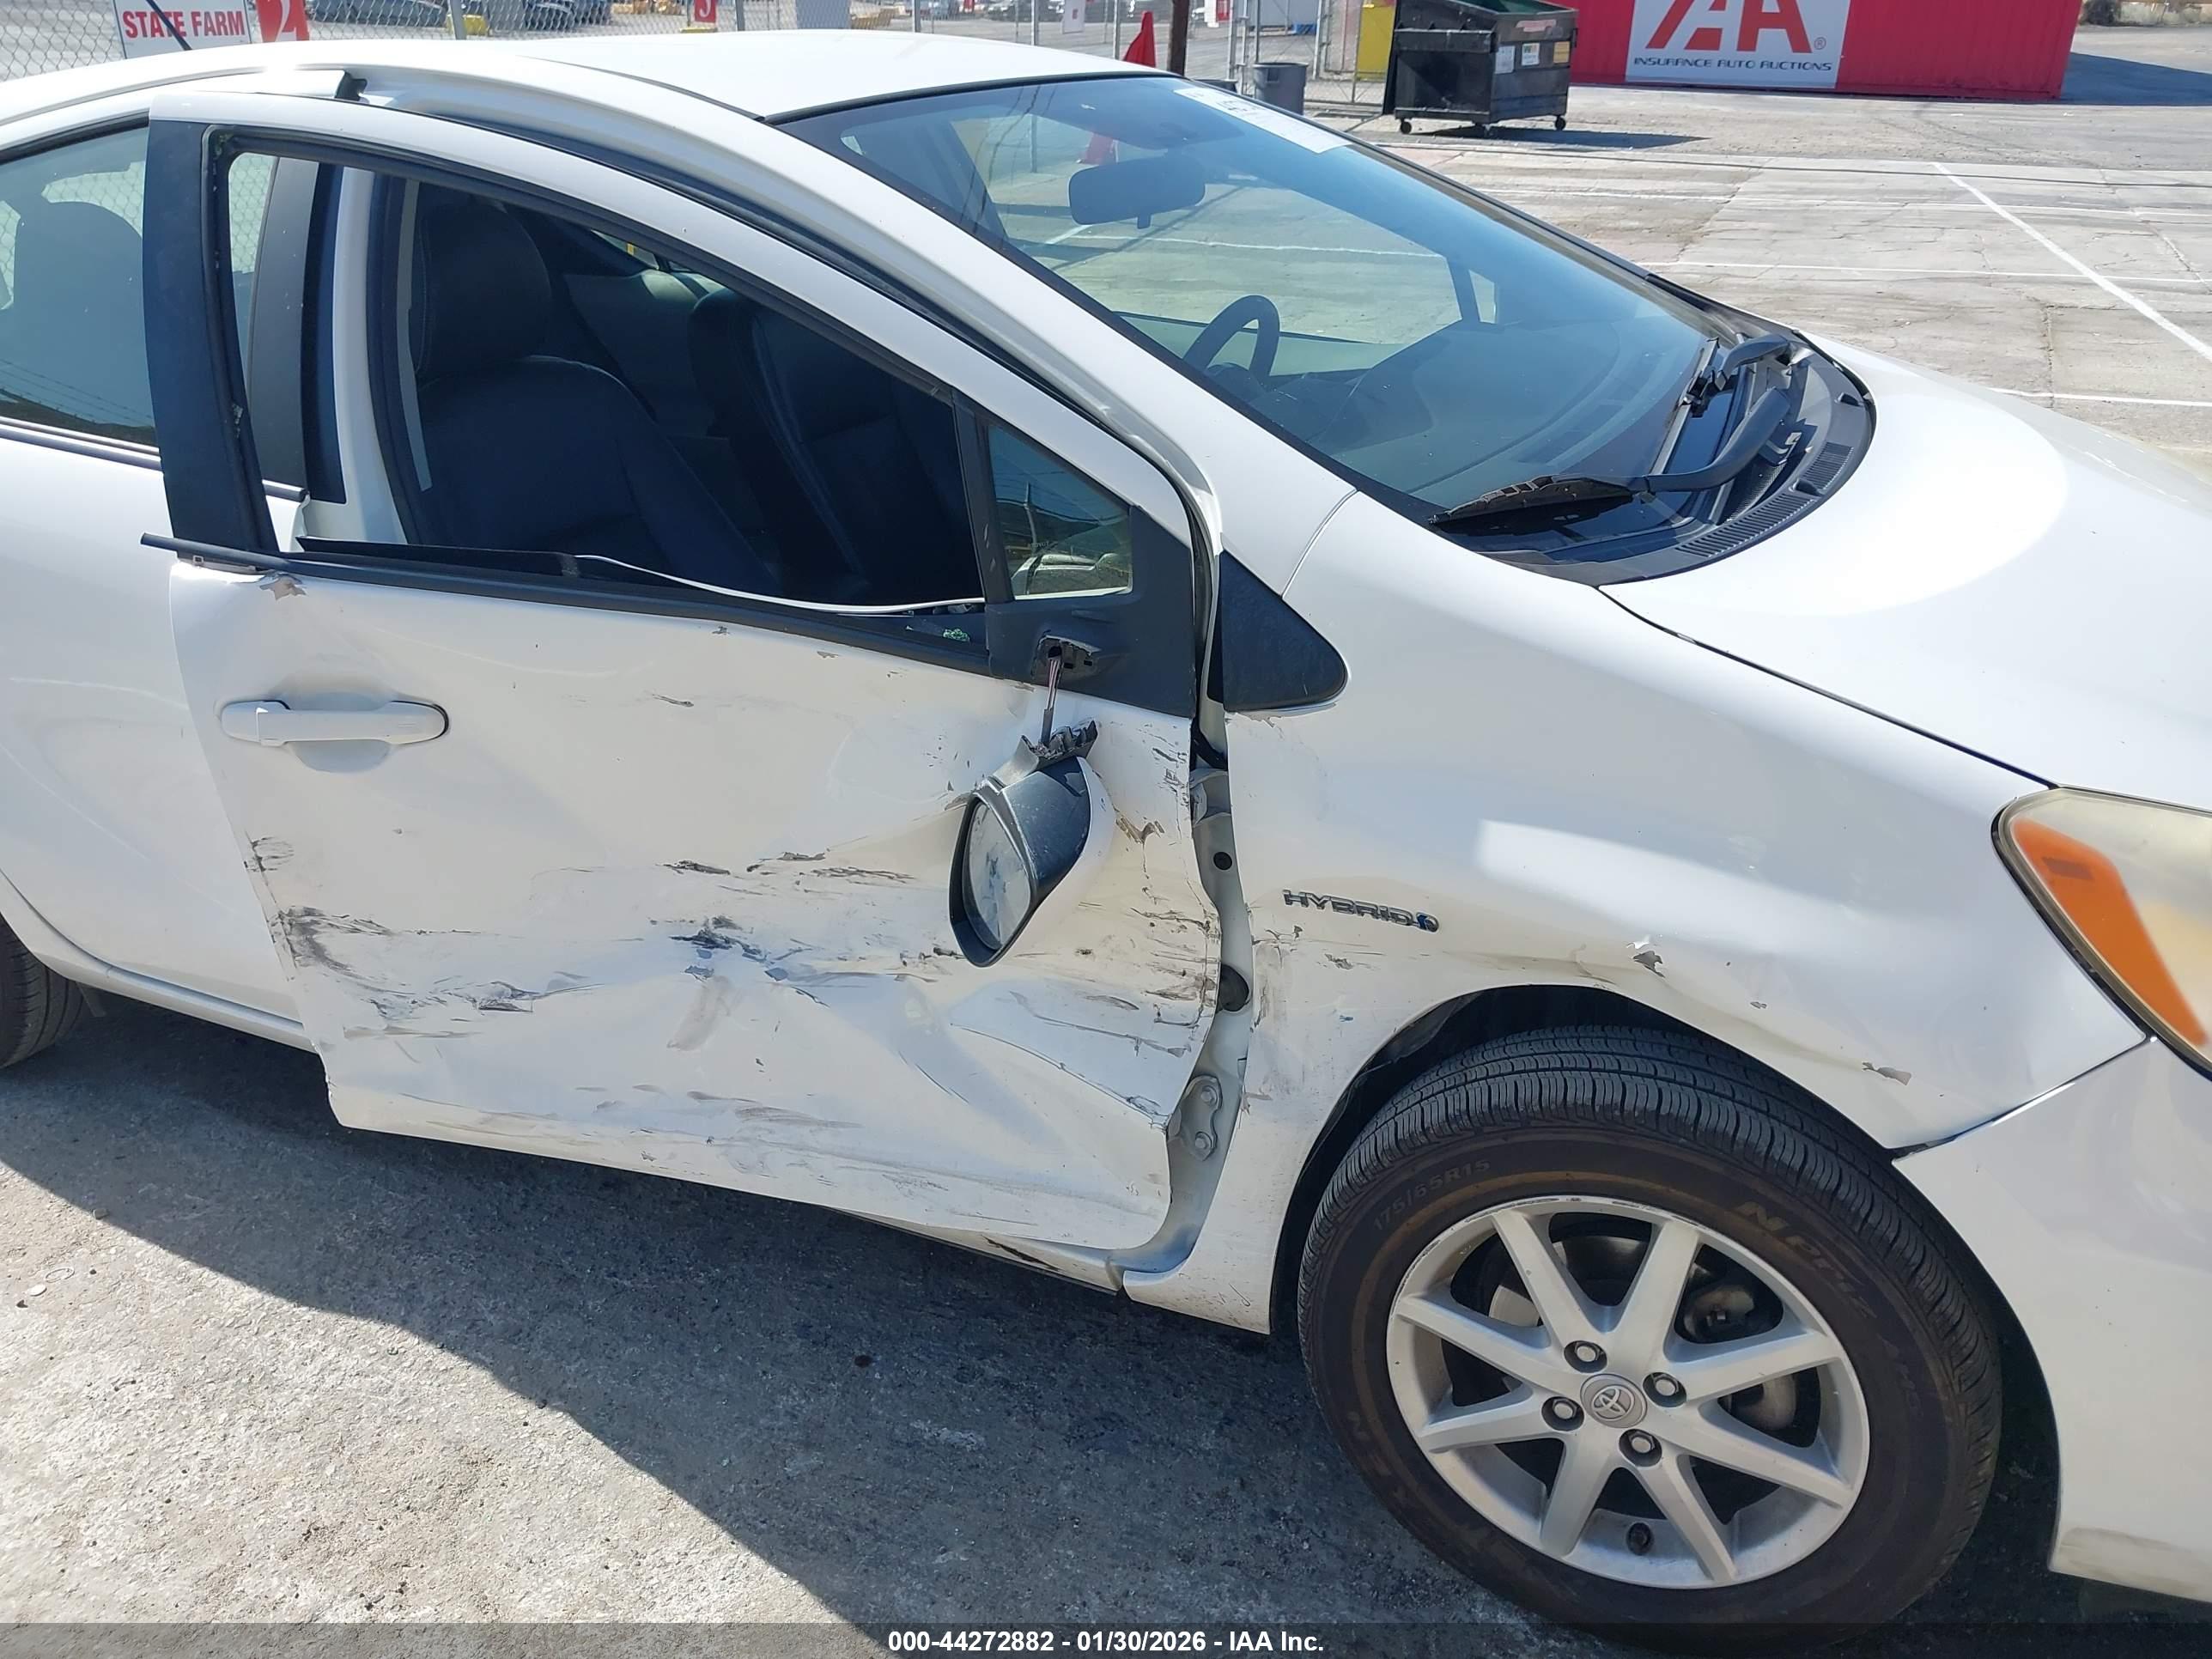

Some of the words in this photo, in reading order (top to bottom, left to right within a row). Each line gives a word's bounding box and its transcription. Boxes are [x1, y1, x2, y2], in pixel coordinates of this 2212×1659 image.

[122, 11, 186, 39] STATE
[191, 10, 246, 37] FARM
[1633, 56, 1712, 68] INSURANCE
[1717, 58, 1756, 69] AUTO
[1759, 58, 1832, 71] AUCTIONS
[1282, 889, 1414, 927] HYBRID
